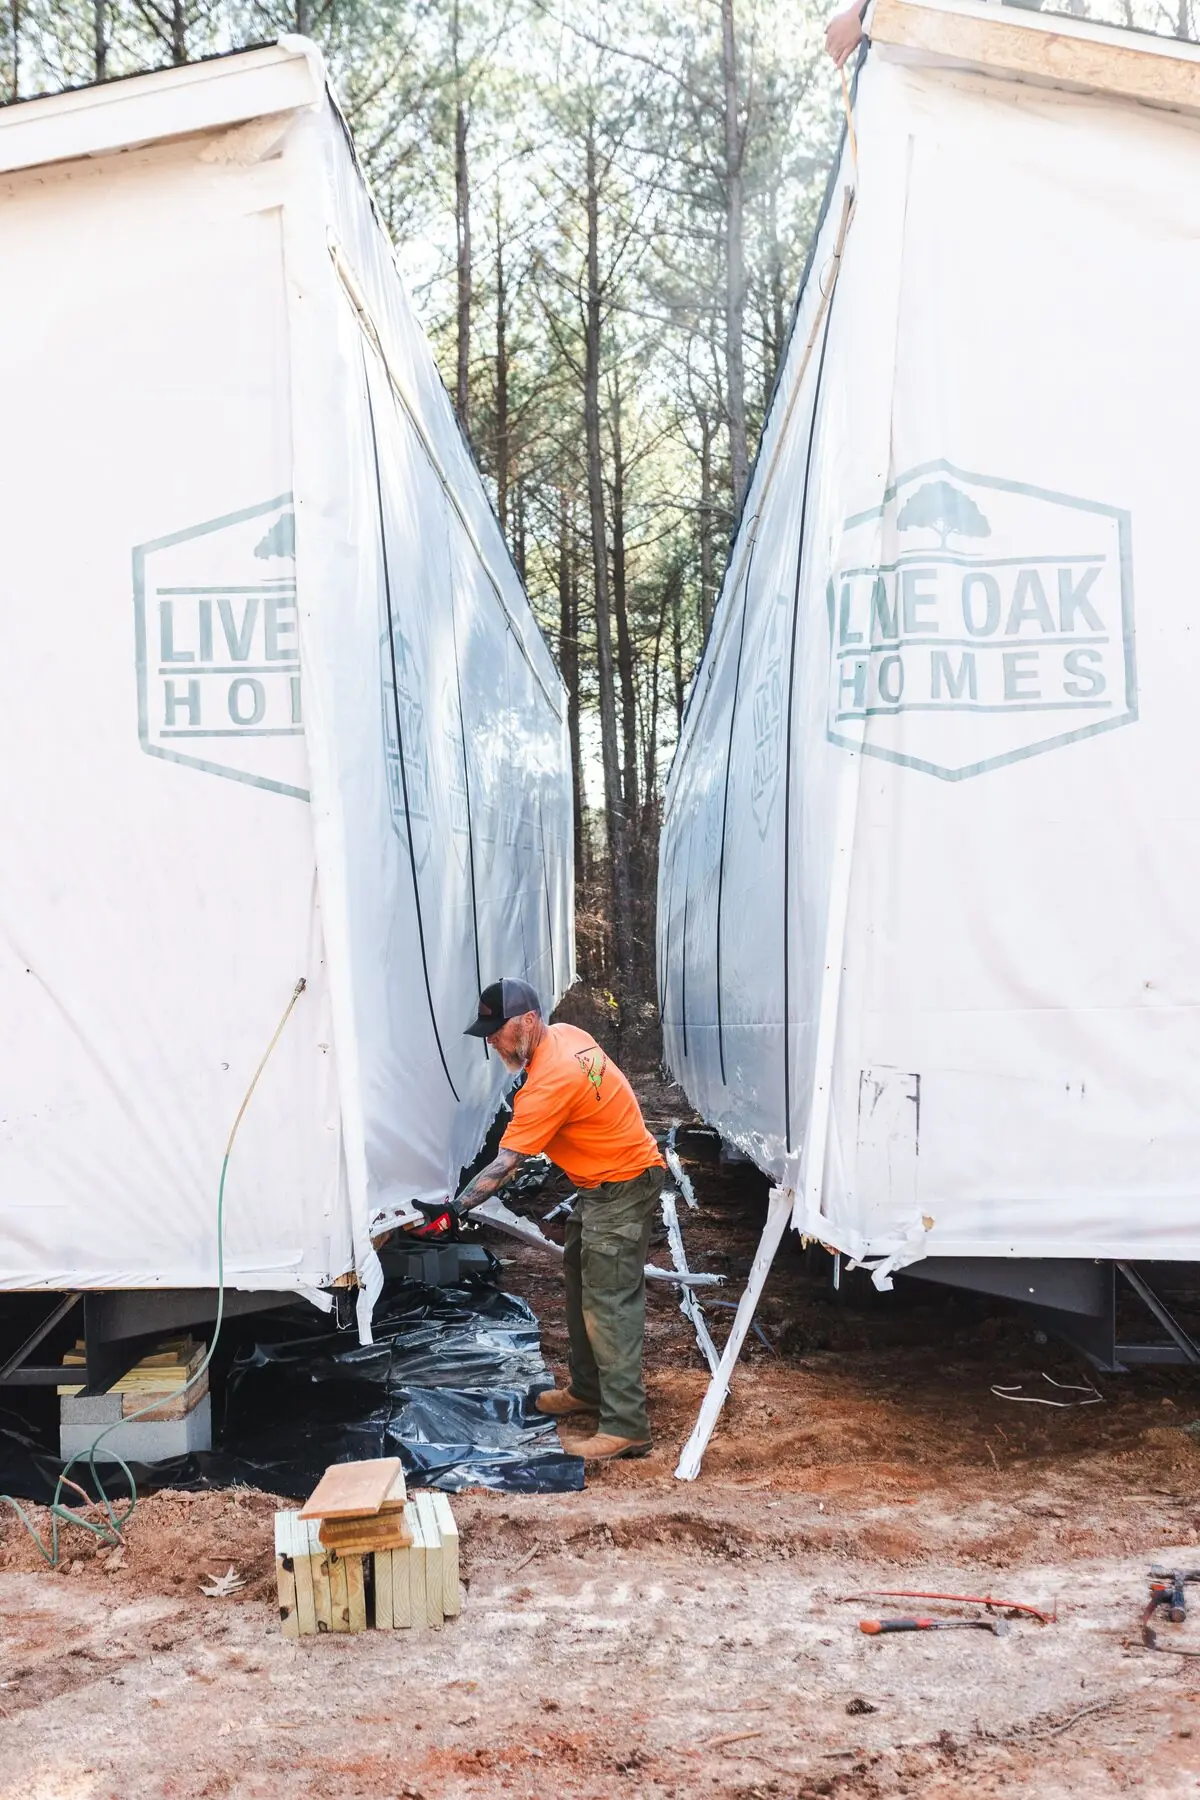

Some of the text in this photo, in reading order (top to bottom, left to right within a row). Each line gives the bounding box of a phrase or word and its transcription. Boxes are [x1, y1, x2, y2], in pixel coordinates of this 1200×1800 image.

[158, 597, 299, 663] LIVE
[961, 567, 1107, 637] OAK
[838, 648, 1107, 709] HOMES
